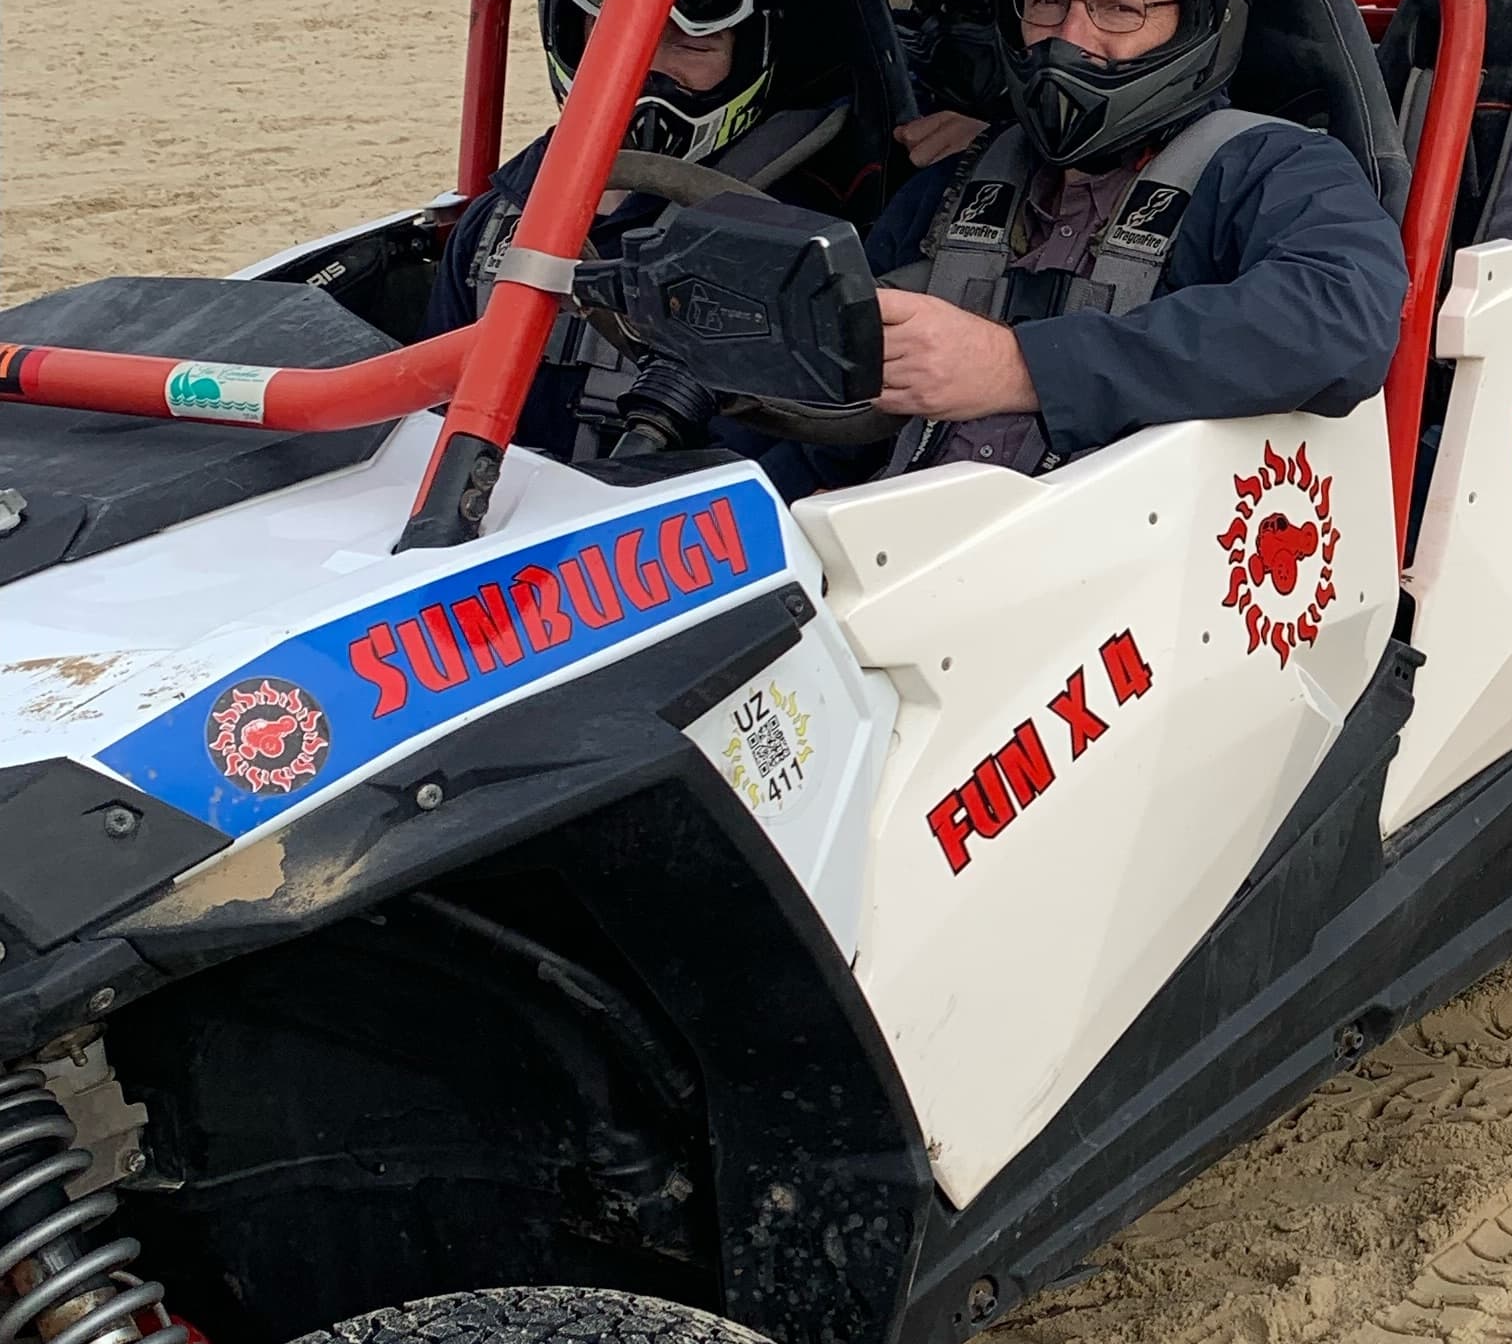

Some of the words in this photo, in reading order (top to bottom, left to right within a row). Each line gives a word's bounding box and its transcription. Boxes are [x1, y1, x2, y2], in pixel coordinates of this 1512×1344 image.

[1112, 224, 1162, 250] DragonFire
[348, 496, 749, 720] SUNBUGGY
[733, 690, 771, 733] UZ
[926, 716, 1056, 876] FUN
[1046, 664, 1110, 762] X
[1098, 627, 1153, 706] 4
[768, 756, 804, 801] 411
